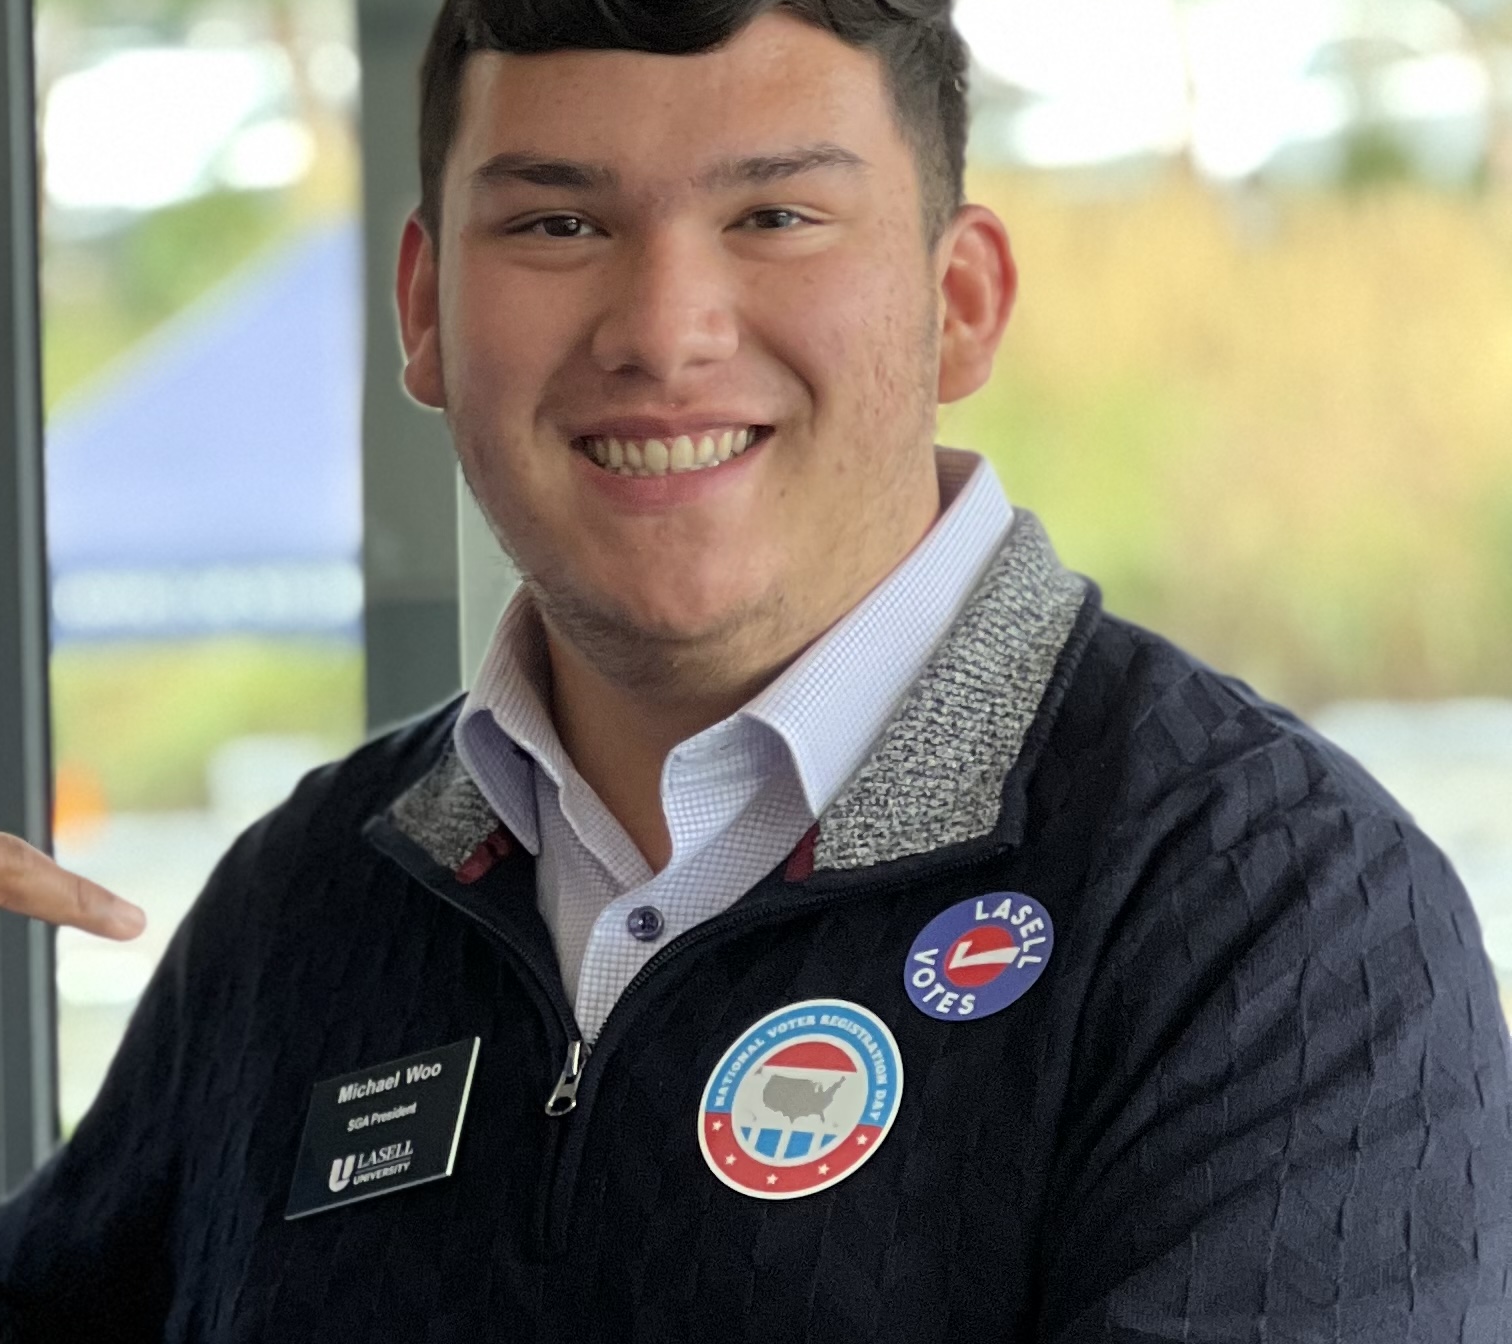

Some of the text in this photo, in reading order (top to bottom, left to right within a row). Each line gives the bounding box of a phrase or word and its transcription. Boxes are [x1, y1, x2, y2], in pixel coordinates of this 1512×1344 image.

[974, 898, 1047, 969] LASELL
[912, 948, 976, 1015] VOTES
[338, 1062, 442, 1105] Michael Woo
[714, 1013, 888, 1122] NATIONAL VOTER REGISTRATION DAY
[346, 1101, 418, 1132] SGA President
[353, 1160, 412, 1186] UNIVERSITY
[356, 1139, 414, 1169] LASELL
